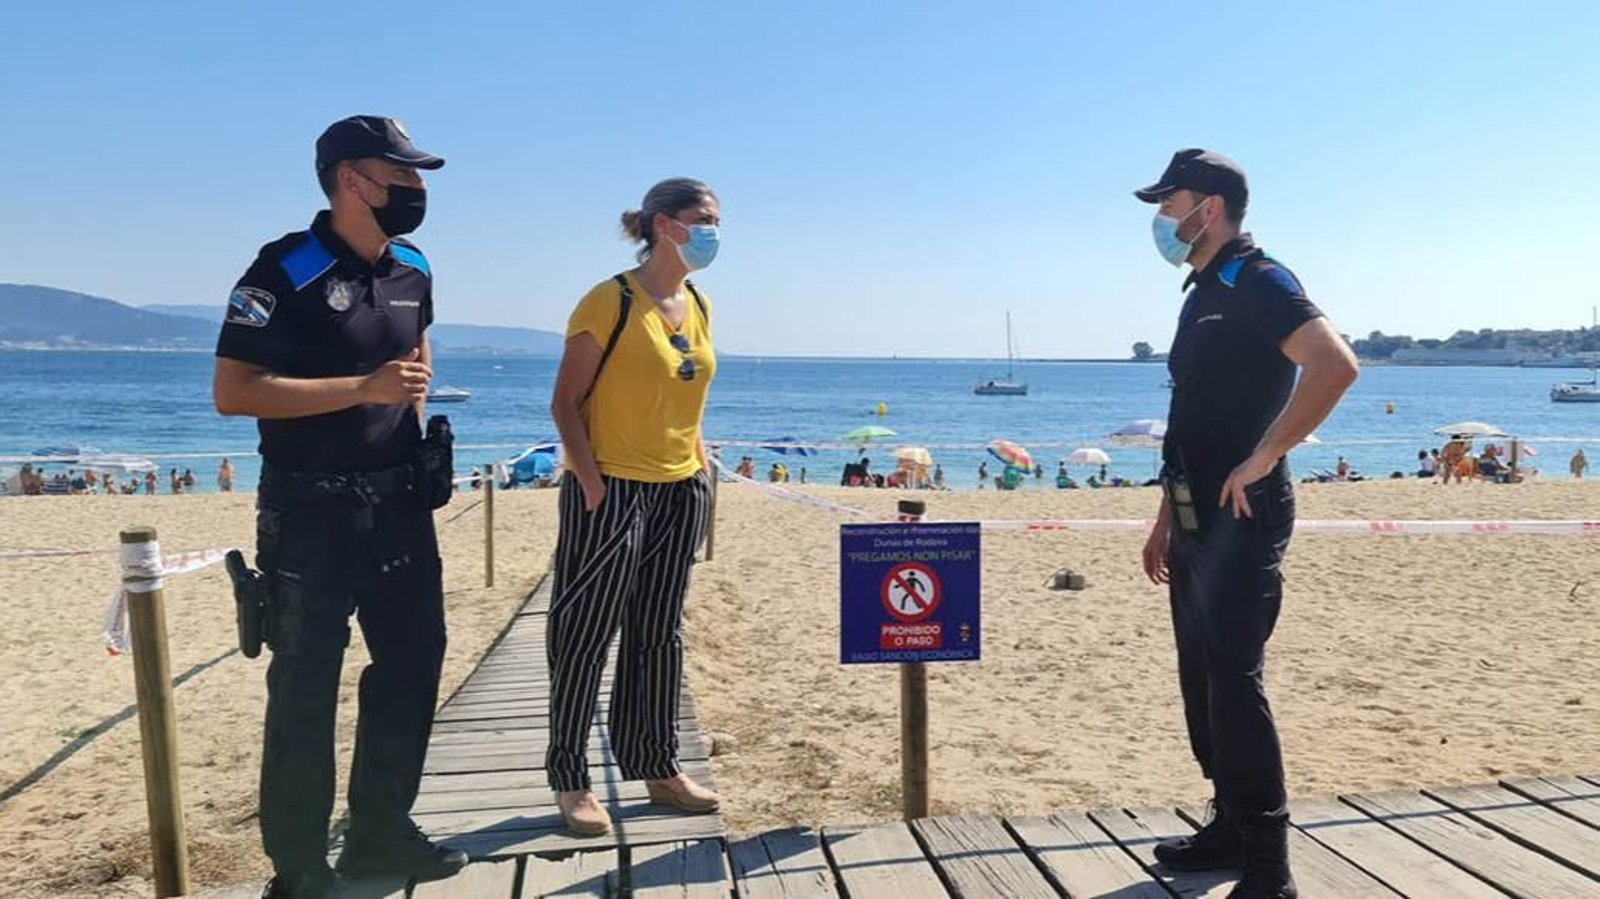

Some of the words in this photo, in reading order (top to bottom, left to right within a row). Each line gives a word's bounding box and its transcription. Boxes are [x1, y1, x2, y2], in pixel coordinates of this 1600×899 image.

[874, 538, 901, 547] Dunas
[902, 538, 914, 547] de
[882, 624, 941, 636] PROHIBIDO
[894, 636, 904, 646] O
[906, 635, 934, 646] PASO
